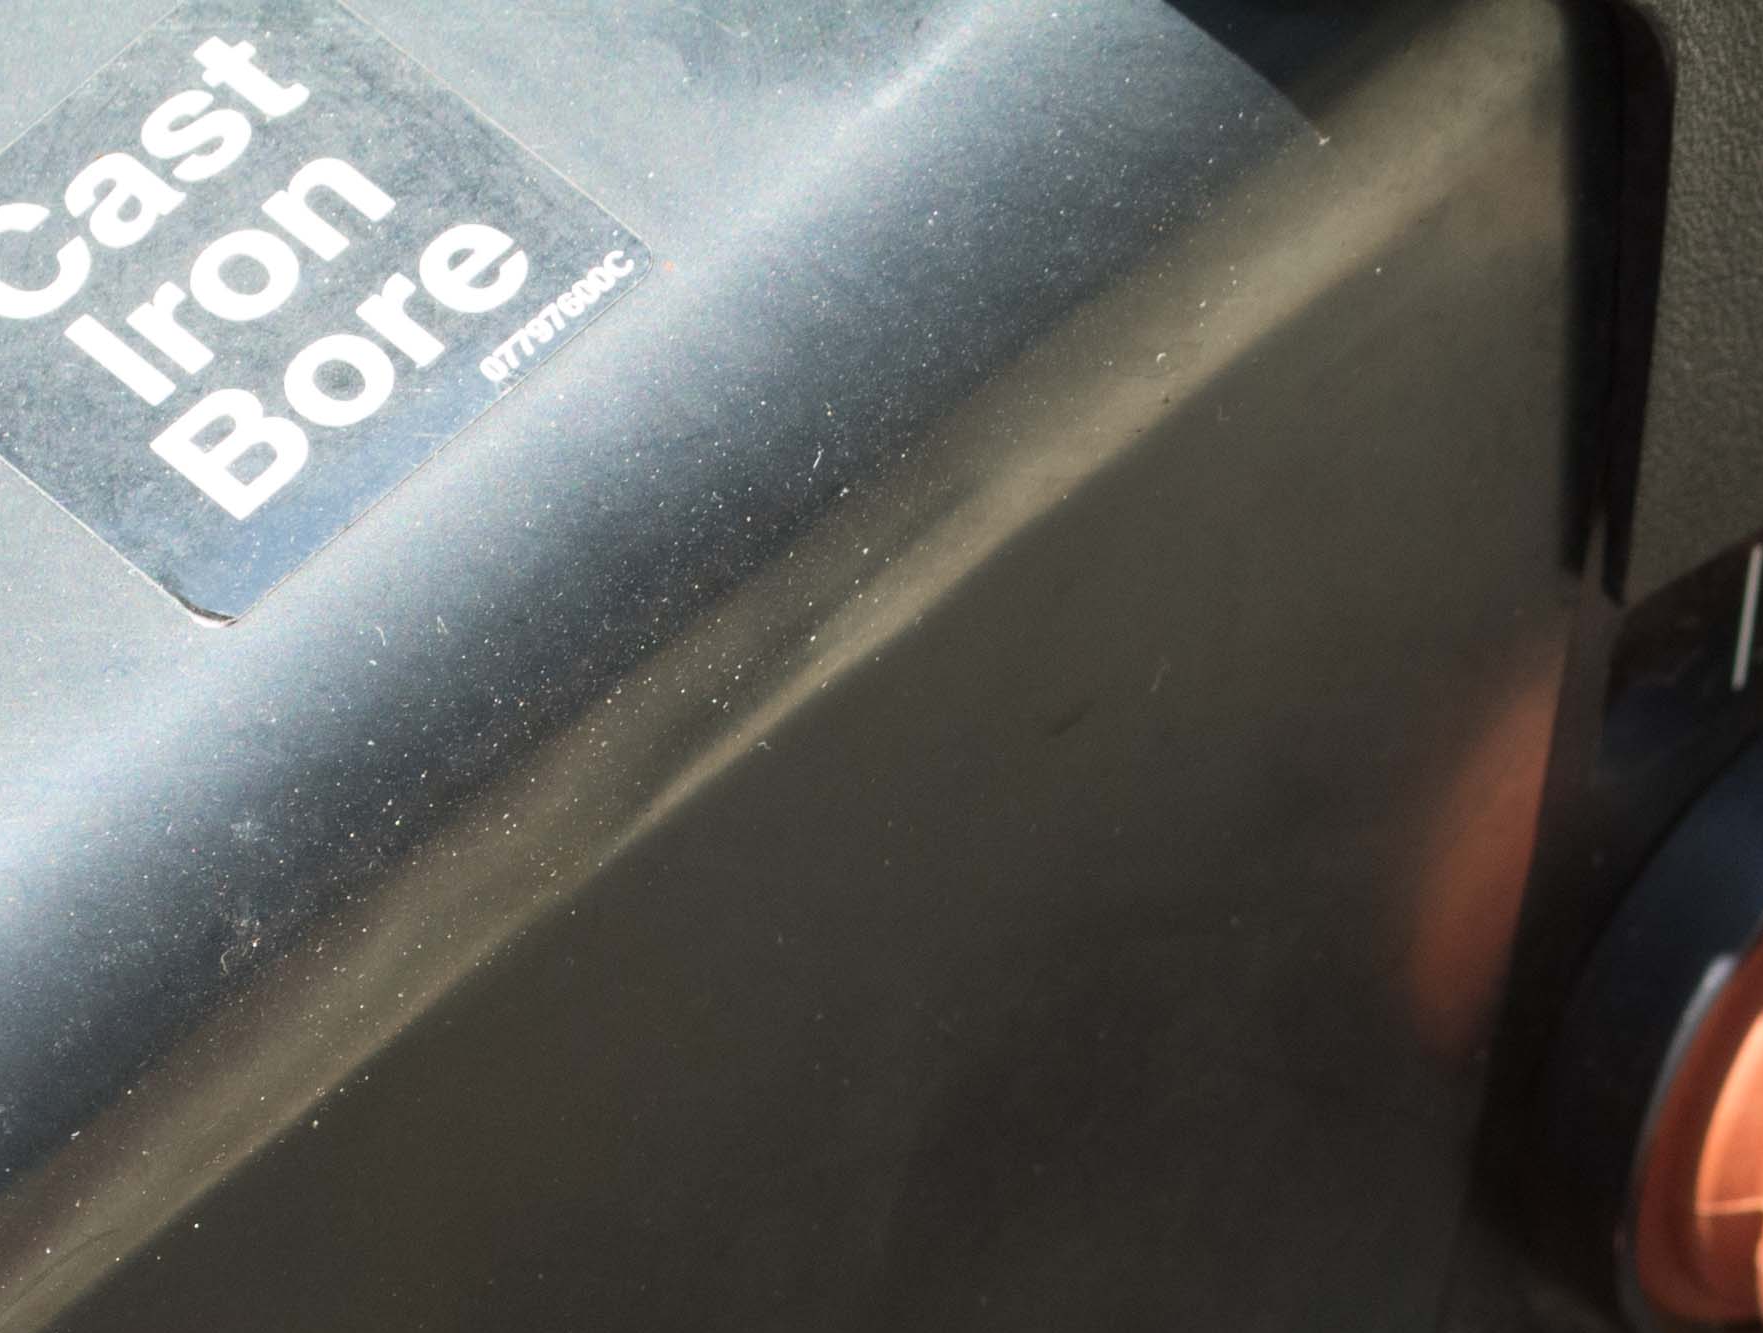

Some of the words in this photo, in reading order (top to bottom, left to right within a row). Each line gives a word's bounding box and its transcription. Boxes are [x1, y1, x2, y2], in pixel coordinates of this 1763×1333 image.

[64, 157, 396, 406] Iron
[150, 223, 528, 520] Bore
[479, 250, 635, 382] 07797600C
